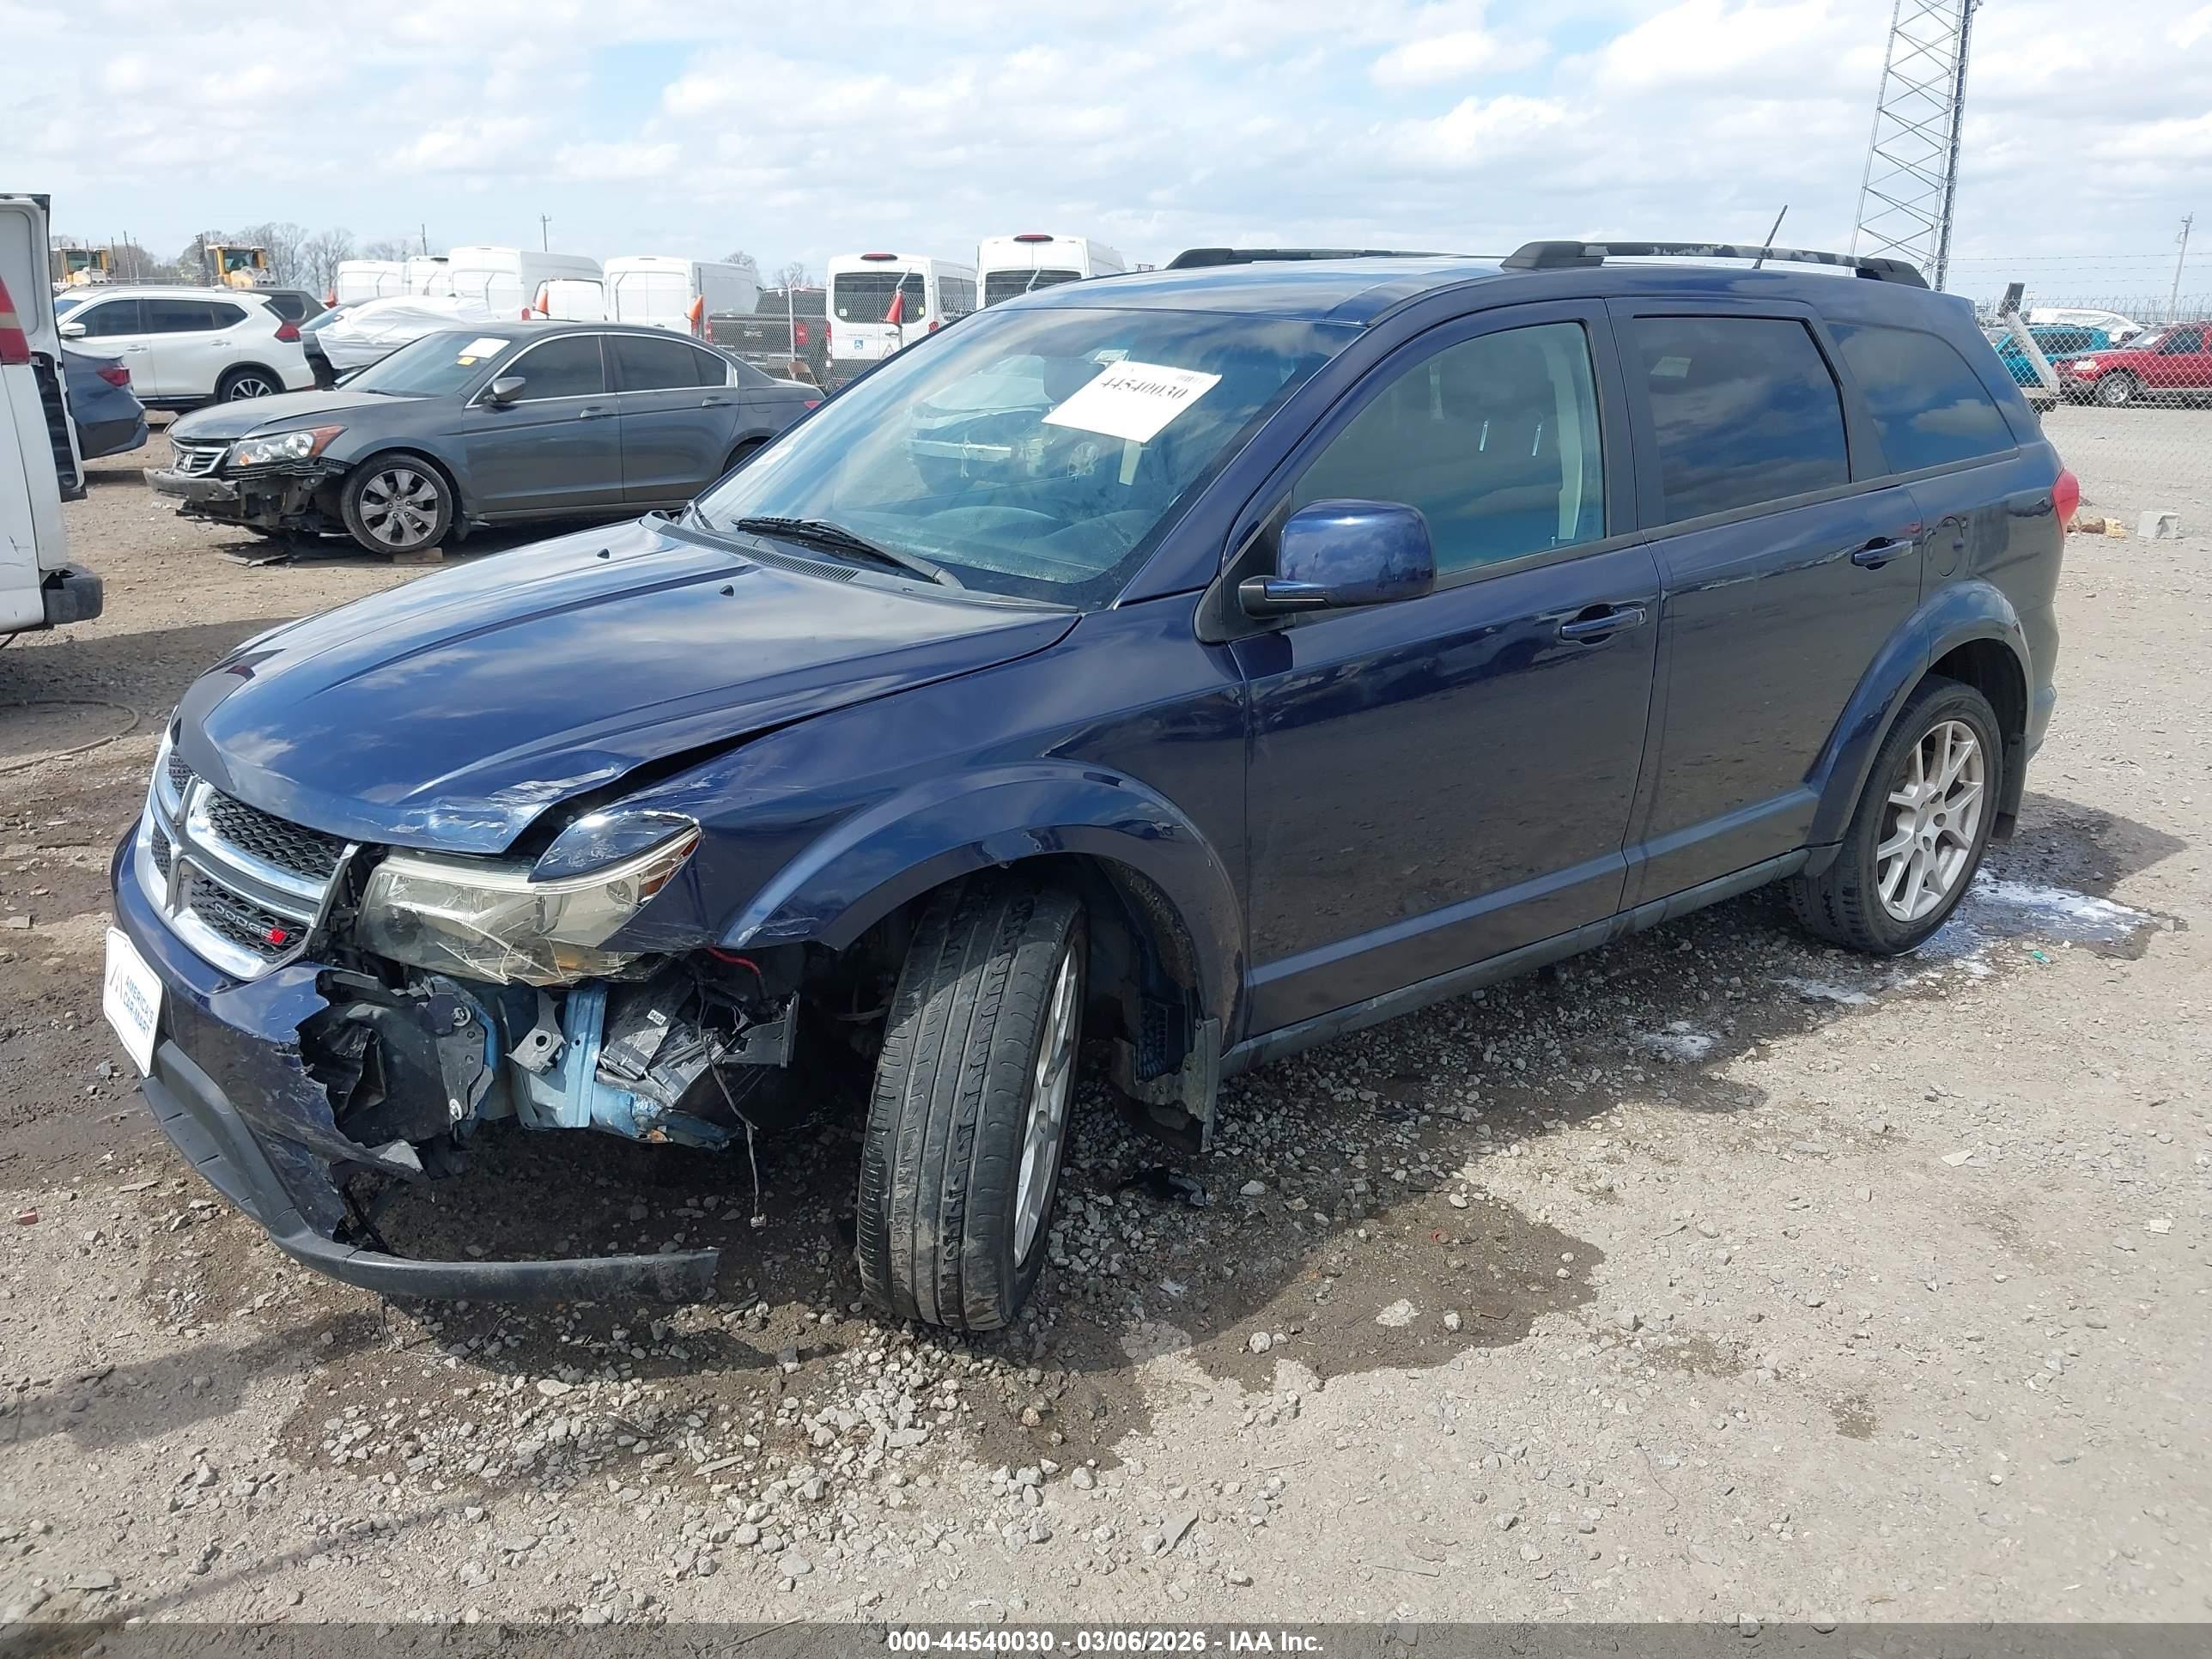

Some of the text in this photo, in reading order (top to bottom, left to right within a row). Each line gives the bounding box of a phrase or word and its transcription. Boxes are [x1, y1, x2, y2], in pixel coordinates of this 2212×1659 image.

[1101, 377, 1188, 399] 44540030
[215, 902, 274, 940] DODGE
[123, 991, 150, 1039] CAR-MART
[125, 975, 155, 1024] AMERICA'S
